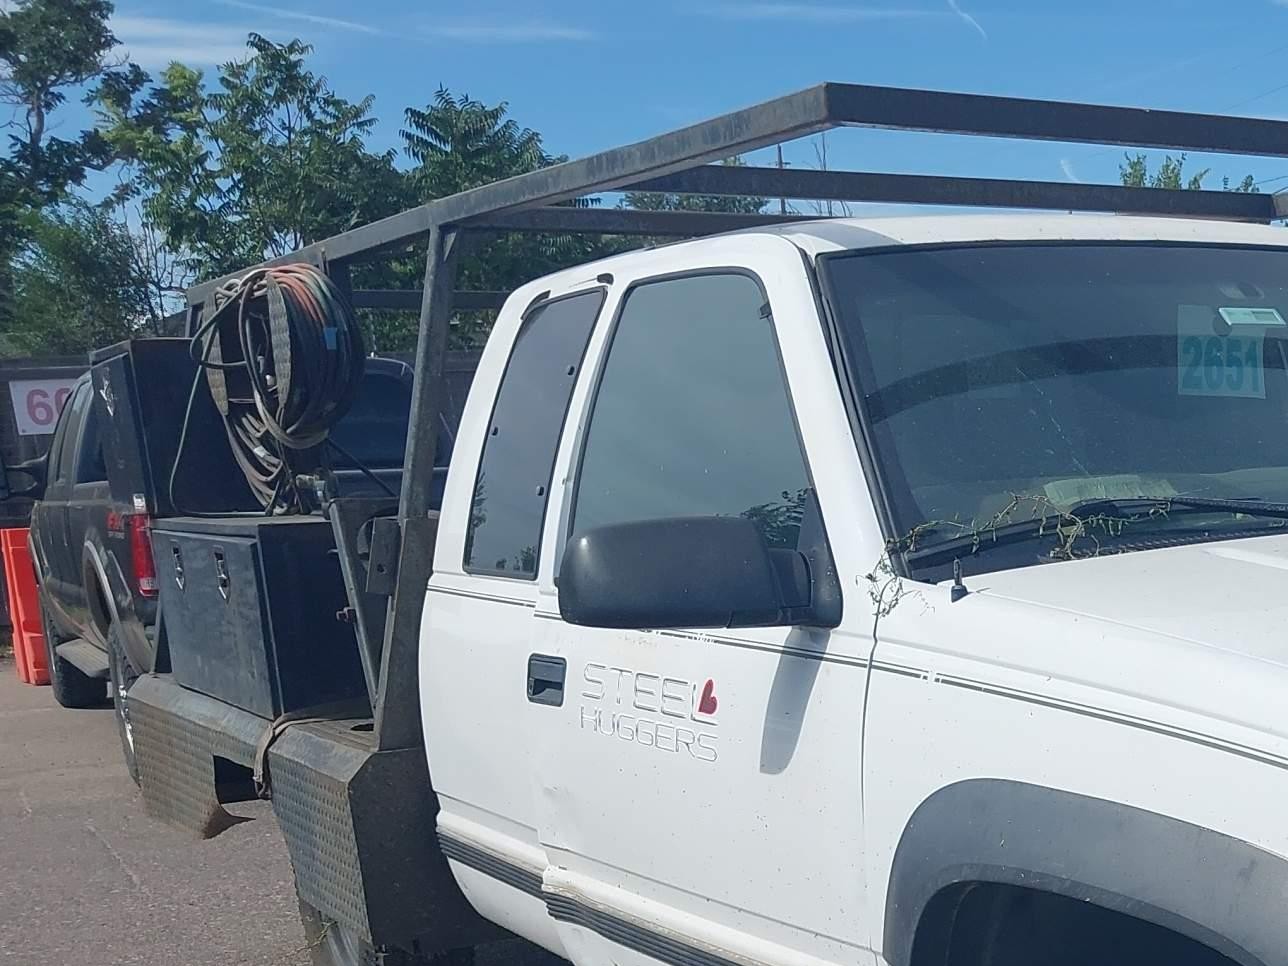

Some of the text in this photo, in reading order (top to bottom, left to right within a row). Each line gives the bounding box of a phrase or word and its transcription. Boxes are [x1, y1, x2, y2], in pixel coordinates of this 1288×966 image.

[1182, 336, 1259, 392] 2651
[582, 662, 718, 726] STEEL
[580, 706, 718, 762] HUGGERS
